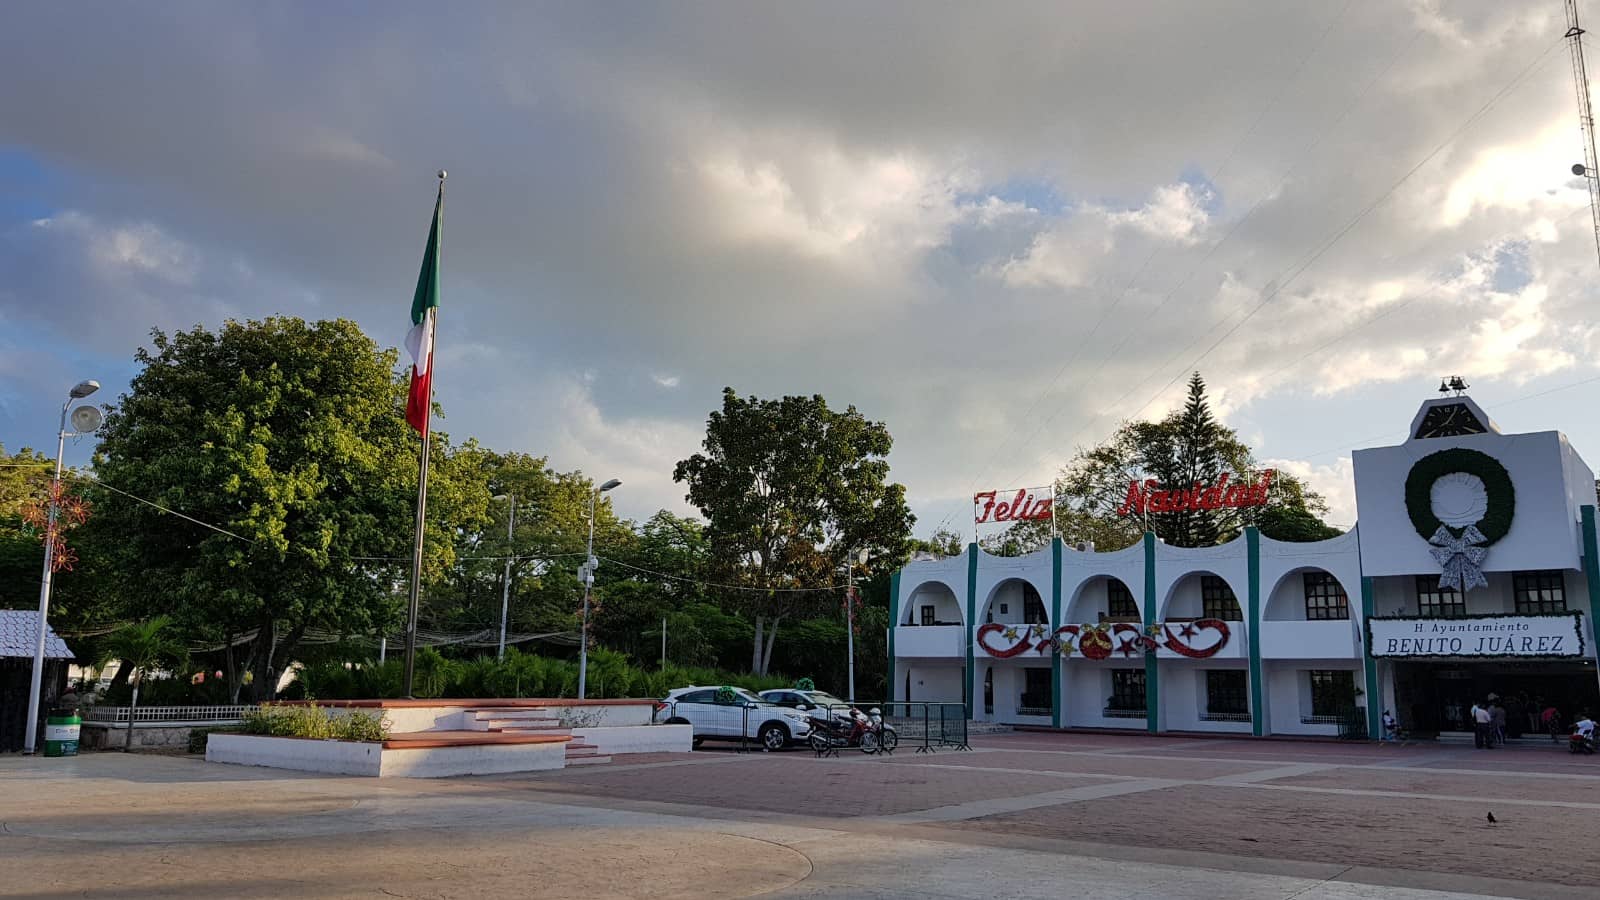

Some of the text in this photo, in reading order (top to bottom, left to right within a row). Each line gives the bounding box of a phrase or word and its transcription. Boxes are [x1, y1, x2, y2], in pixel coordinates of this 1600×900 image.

[974, 468, 1273, 523] Feliz Navidad
[1431, 622, 1530, 635] Ayuntamiento
[1387, 634, 1565, 653] BENITO JUÁREZ
